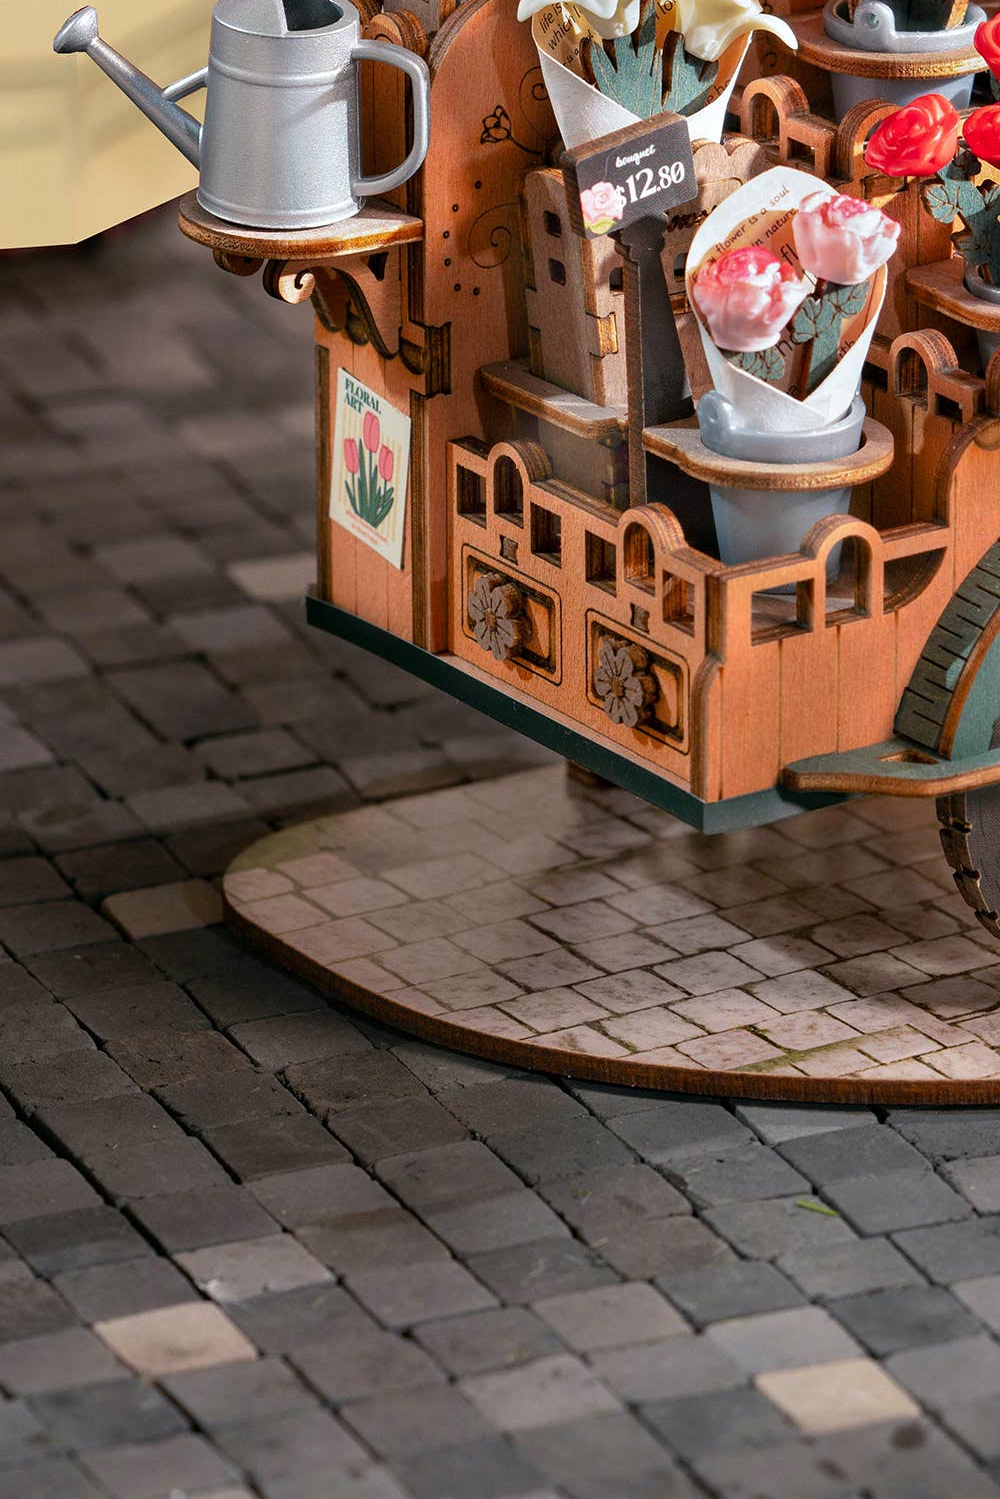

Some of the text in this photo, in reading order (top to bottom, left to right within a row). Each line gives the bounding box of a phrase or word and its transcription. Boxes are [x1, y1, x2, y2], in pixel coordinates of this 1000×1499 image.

[539, 12, 554, 34] life
[548, 15, 577, 50] which
[615, 144, 657, 168] bouquet
[614, 161, 686, 211] $12.80
[715, 184, 791, 253] flower is a soul
[343, 392, 364, 414] ART
[344, 377, 382, 415] FLORAL
